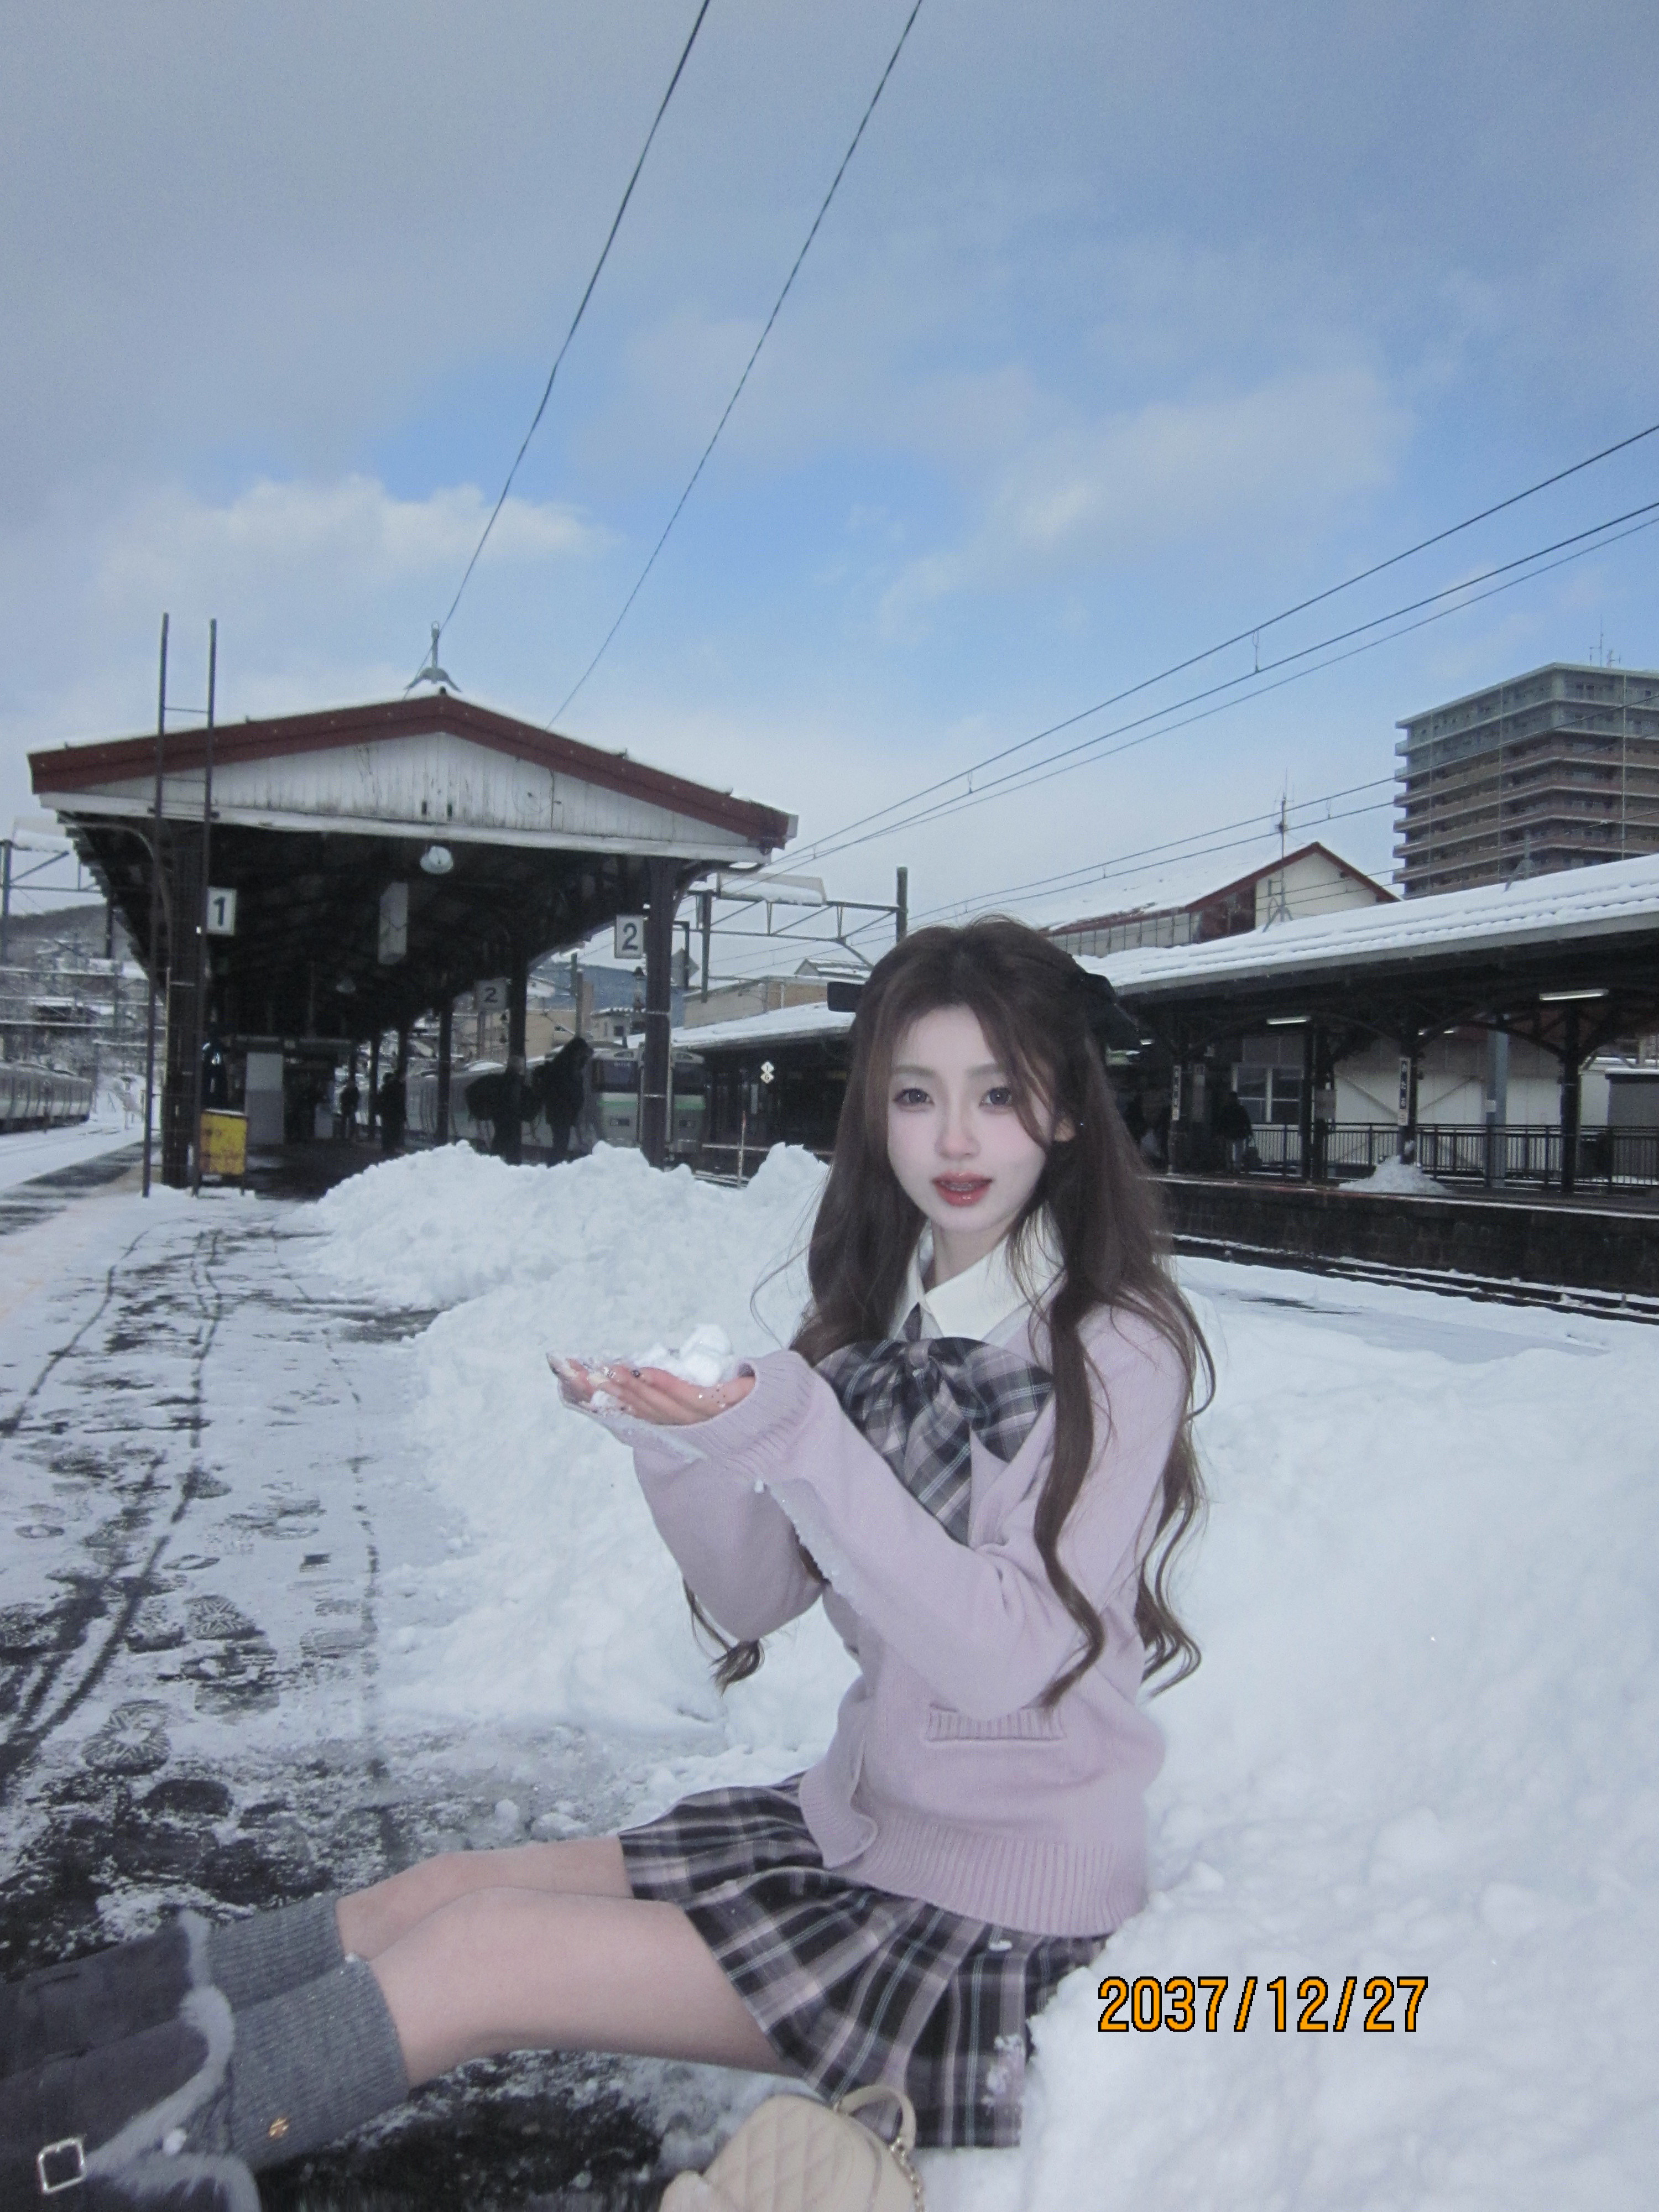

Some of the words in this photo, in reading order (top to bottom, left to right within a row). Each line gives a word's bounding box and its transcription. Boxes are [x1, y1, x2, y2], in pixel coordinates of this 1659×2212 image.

[213, 896, 225, 927] 1
[622, 922, 638, 951] 2
[484, 987, 498, 1003] 2
